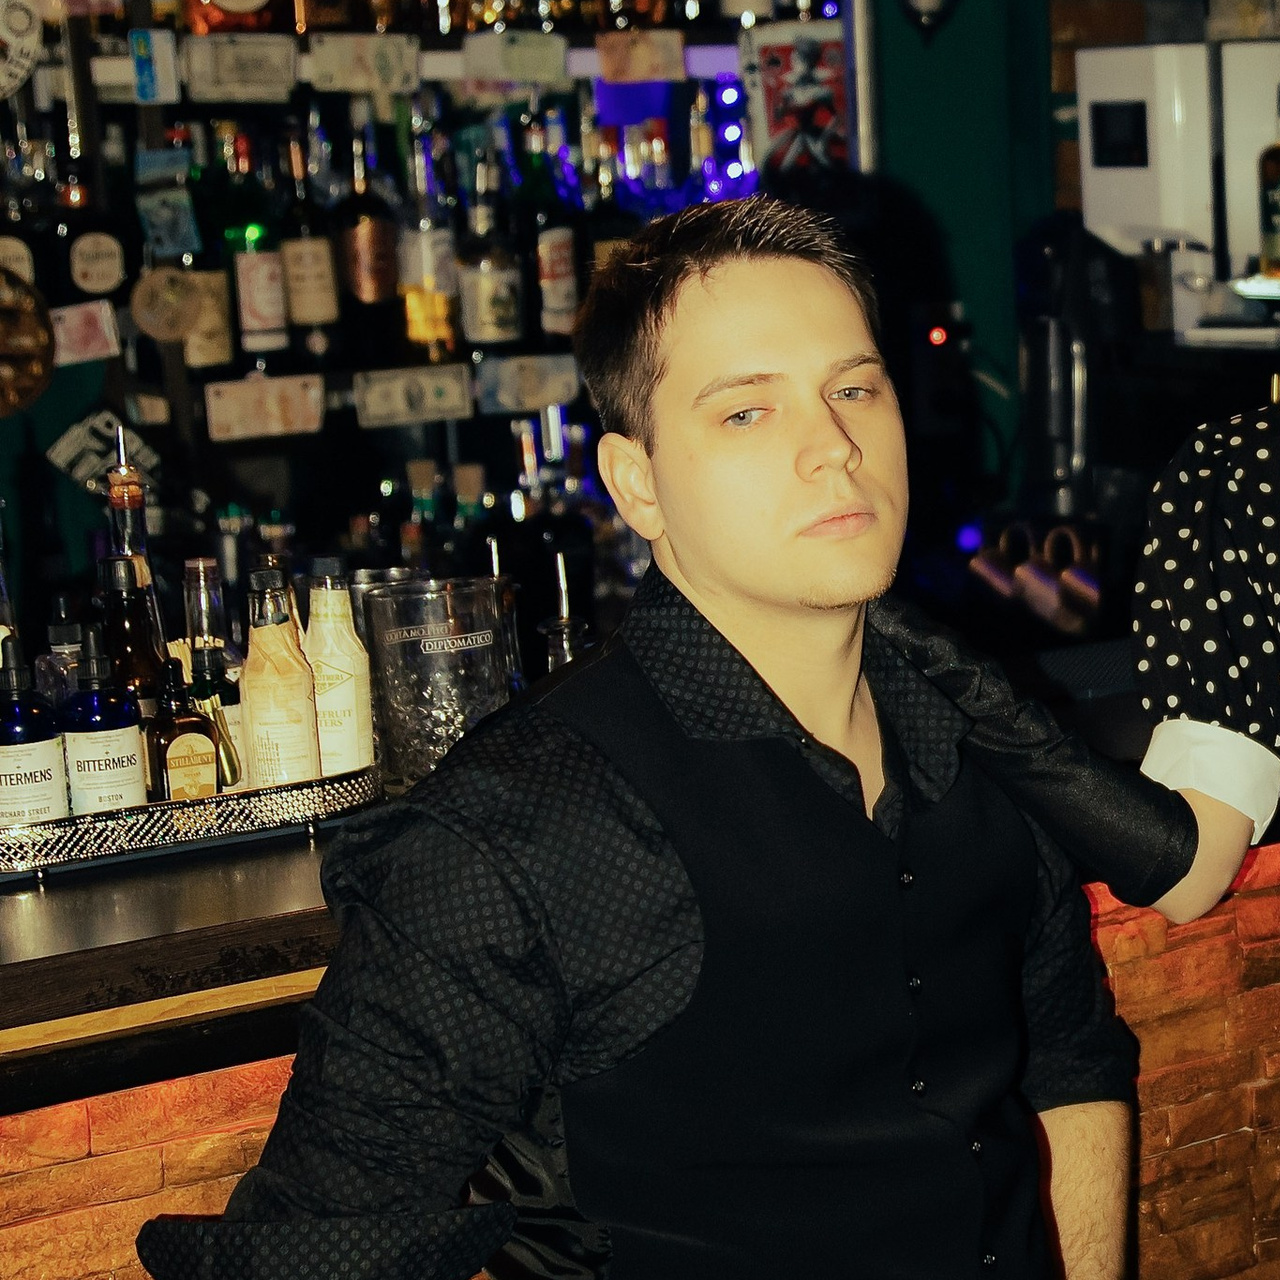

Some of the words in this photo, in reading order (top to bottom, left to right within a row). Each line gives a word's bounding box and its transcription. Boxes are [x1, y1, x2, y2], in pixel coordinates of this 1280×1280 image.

[76, 753, 138, 773] BITTERMENS
[98, 793, 123, 803] BOSTON
[28, 806, 50, 816] STREET
